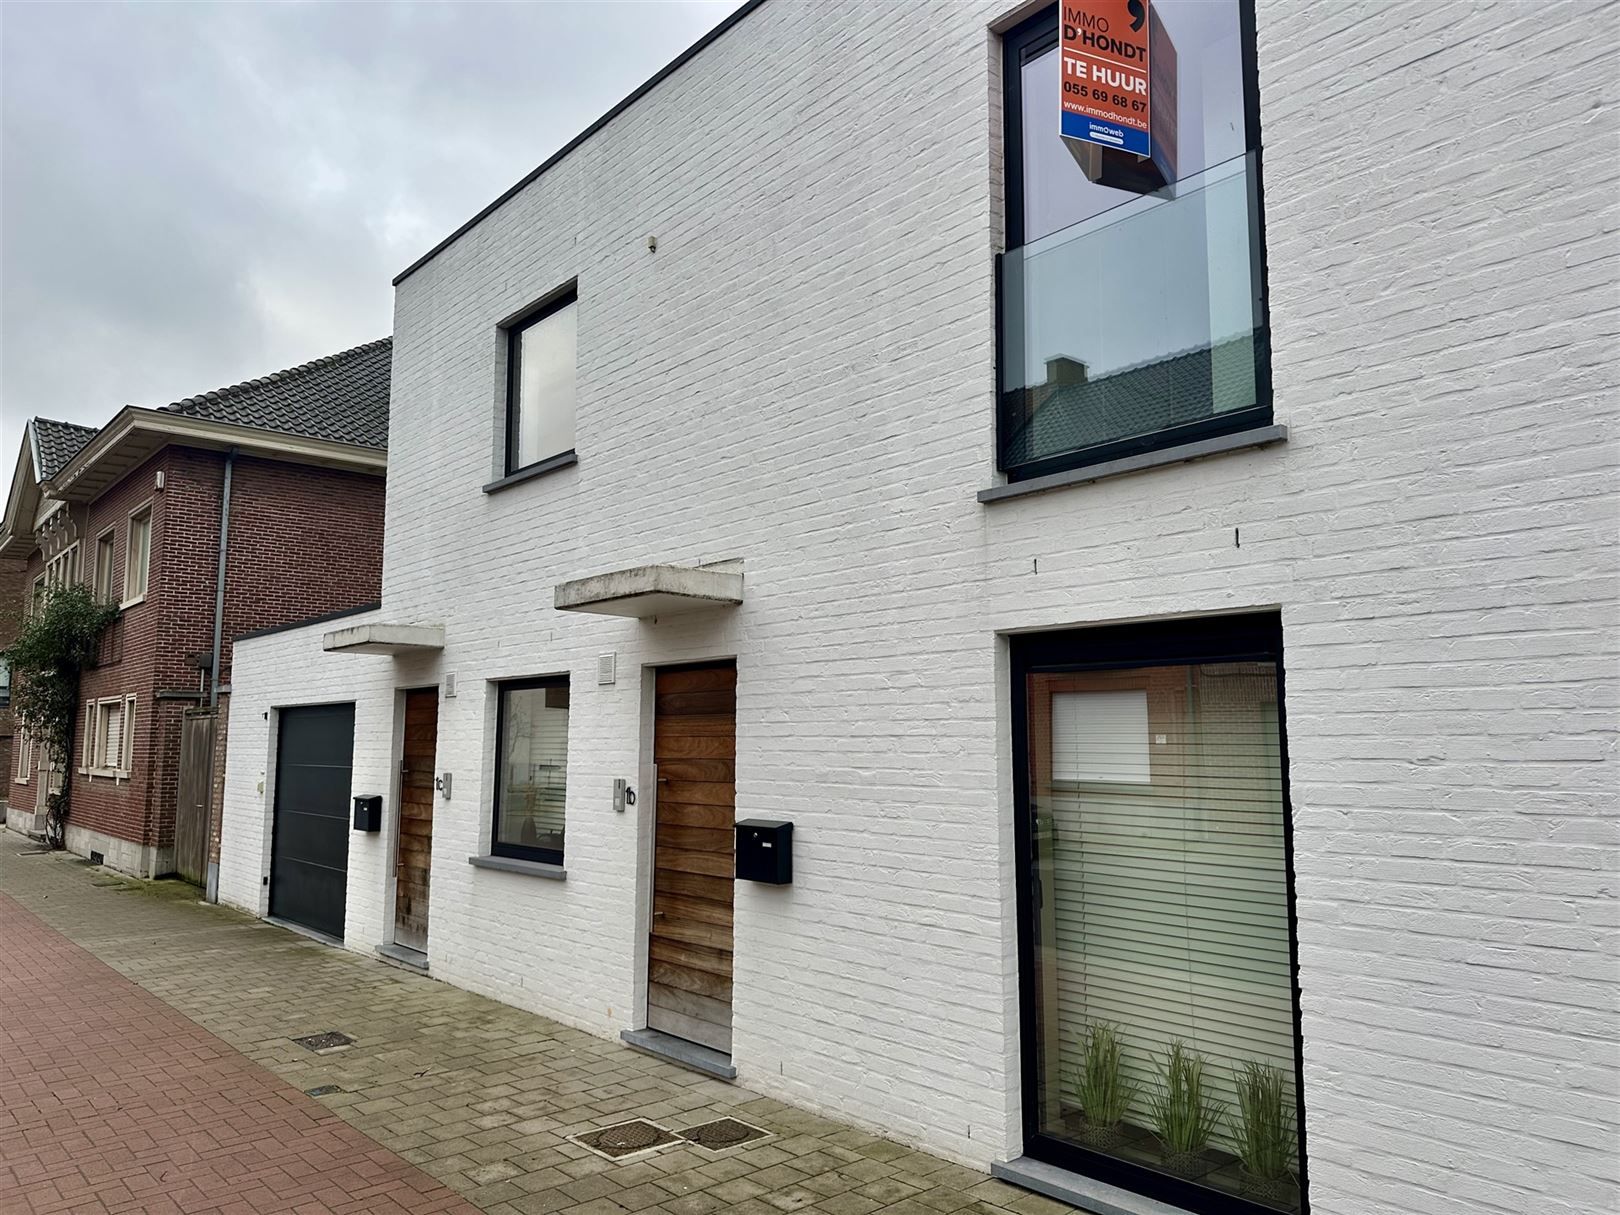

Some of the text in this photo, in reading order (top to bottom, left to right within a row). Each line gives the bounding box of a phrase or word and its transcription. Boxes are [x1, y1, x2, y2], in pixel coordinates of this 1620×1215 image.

[1064, 6, 1109, 32] IMMO
[1064, 24, 1146, 62] D'HONDT
[1064, 57, 1146, 95] TE HUUR
[1064, 81, 1146, 112] 055 69 68 67
[1064, 101, 1147, 129] www.immodhondt.be
